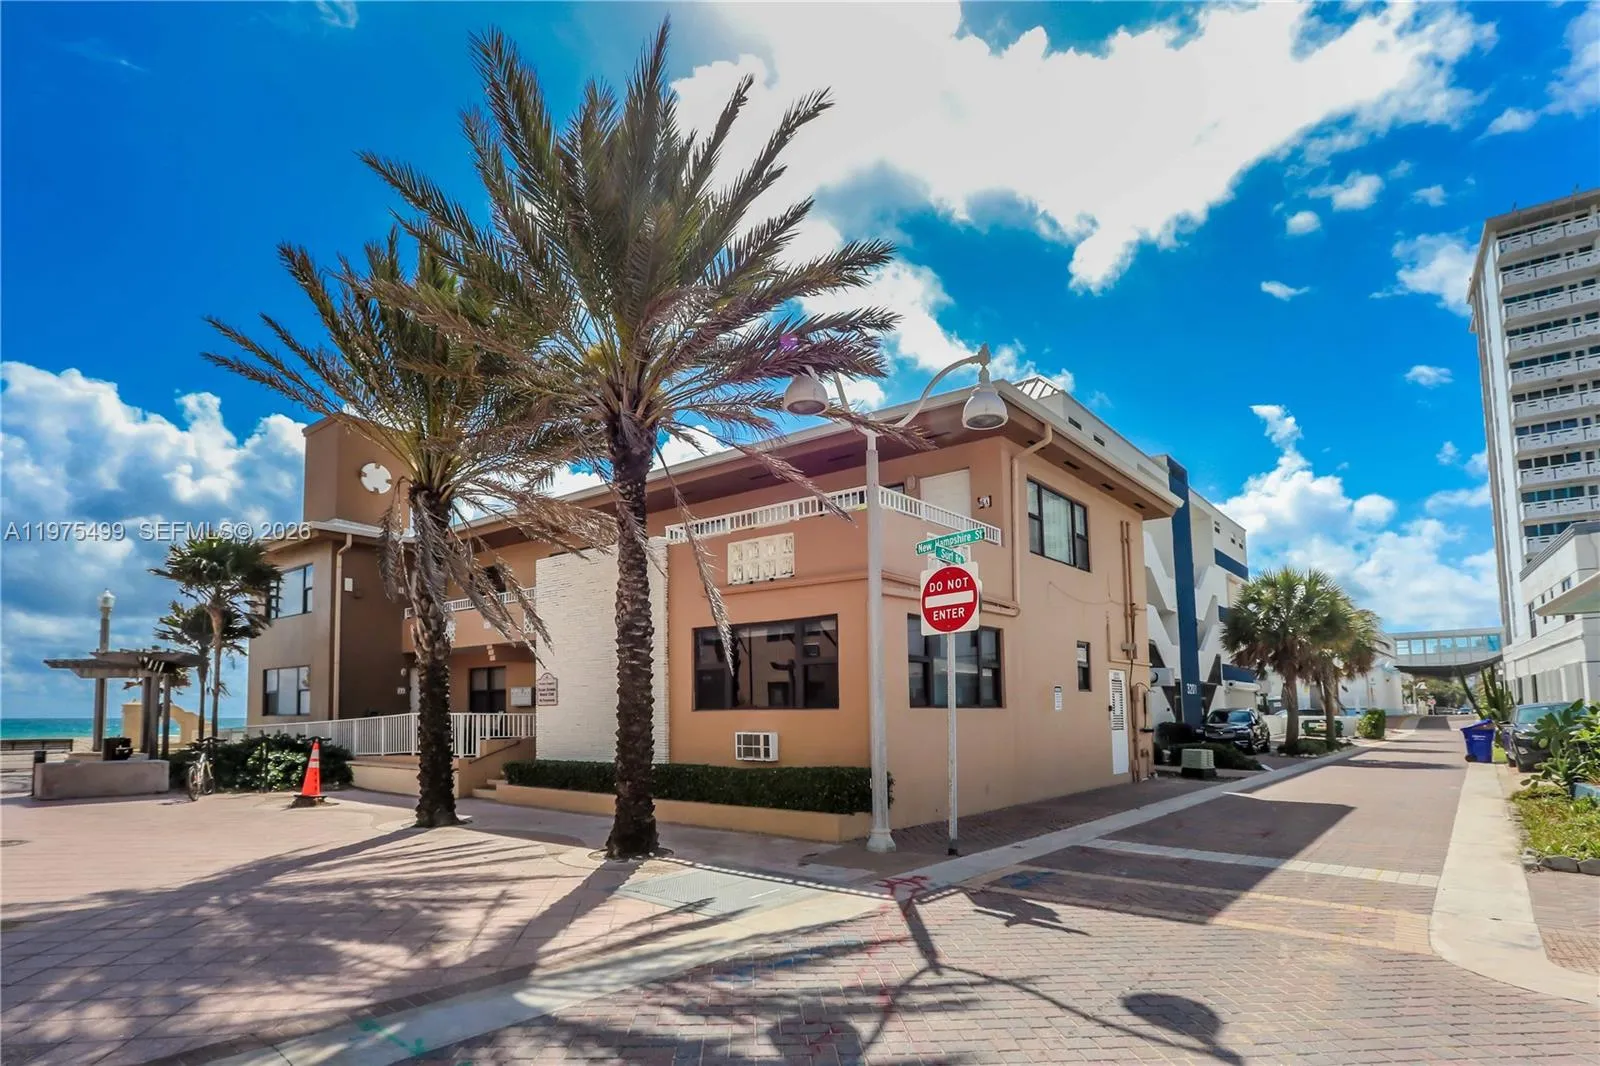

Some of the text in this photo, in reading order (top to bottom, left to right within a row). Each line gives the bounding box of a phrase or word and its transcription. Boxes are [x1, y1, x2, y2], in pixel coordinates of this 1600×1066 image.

[918, 529, 983, 553] New Hampshire St
[941, 549, 954, 560] Surf
[929, 577, 968, 593] DO NOT
[933, 607, 965, 621] ENTER
